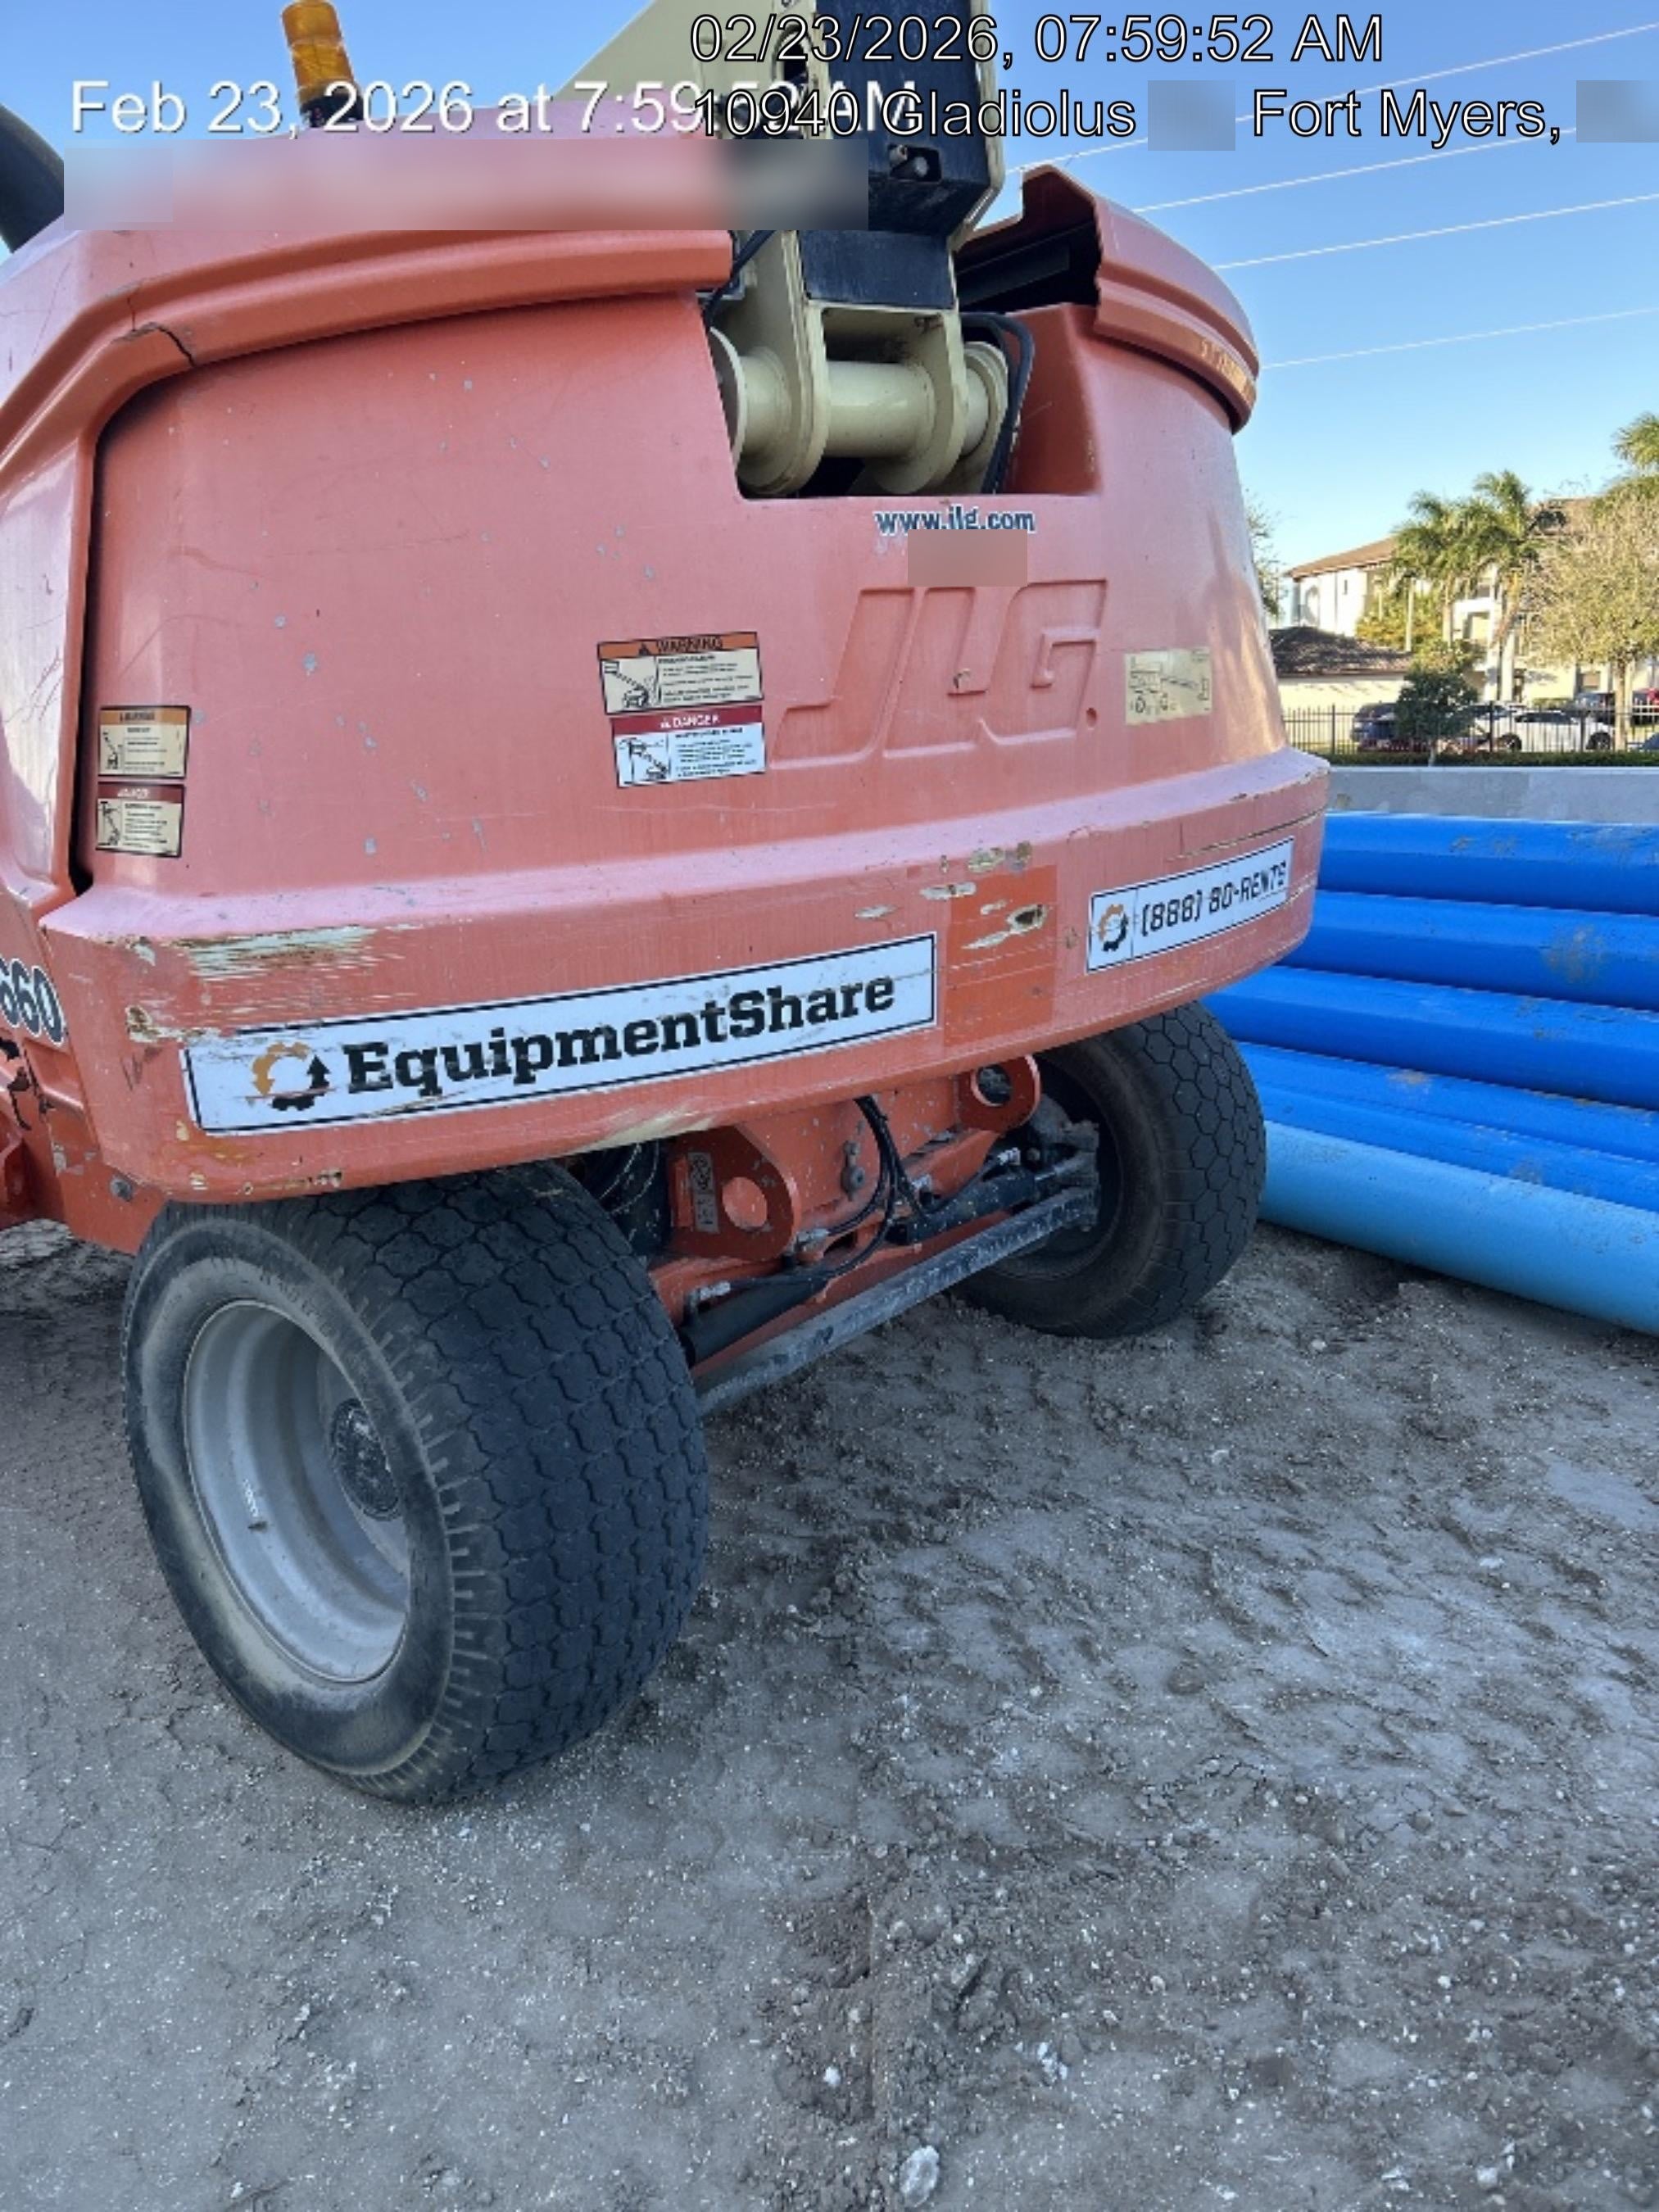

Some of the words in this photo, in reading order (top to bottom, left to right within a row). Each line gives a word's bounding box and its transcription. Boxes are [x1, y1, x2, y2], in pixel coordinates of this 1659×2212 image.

[770, 578, 1108, 770] JLG
[1141, 890, 1202, 937] (888)
[342, 977, 895, 1098] EquipmentShare
